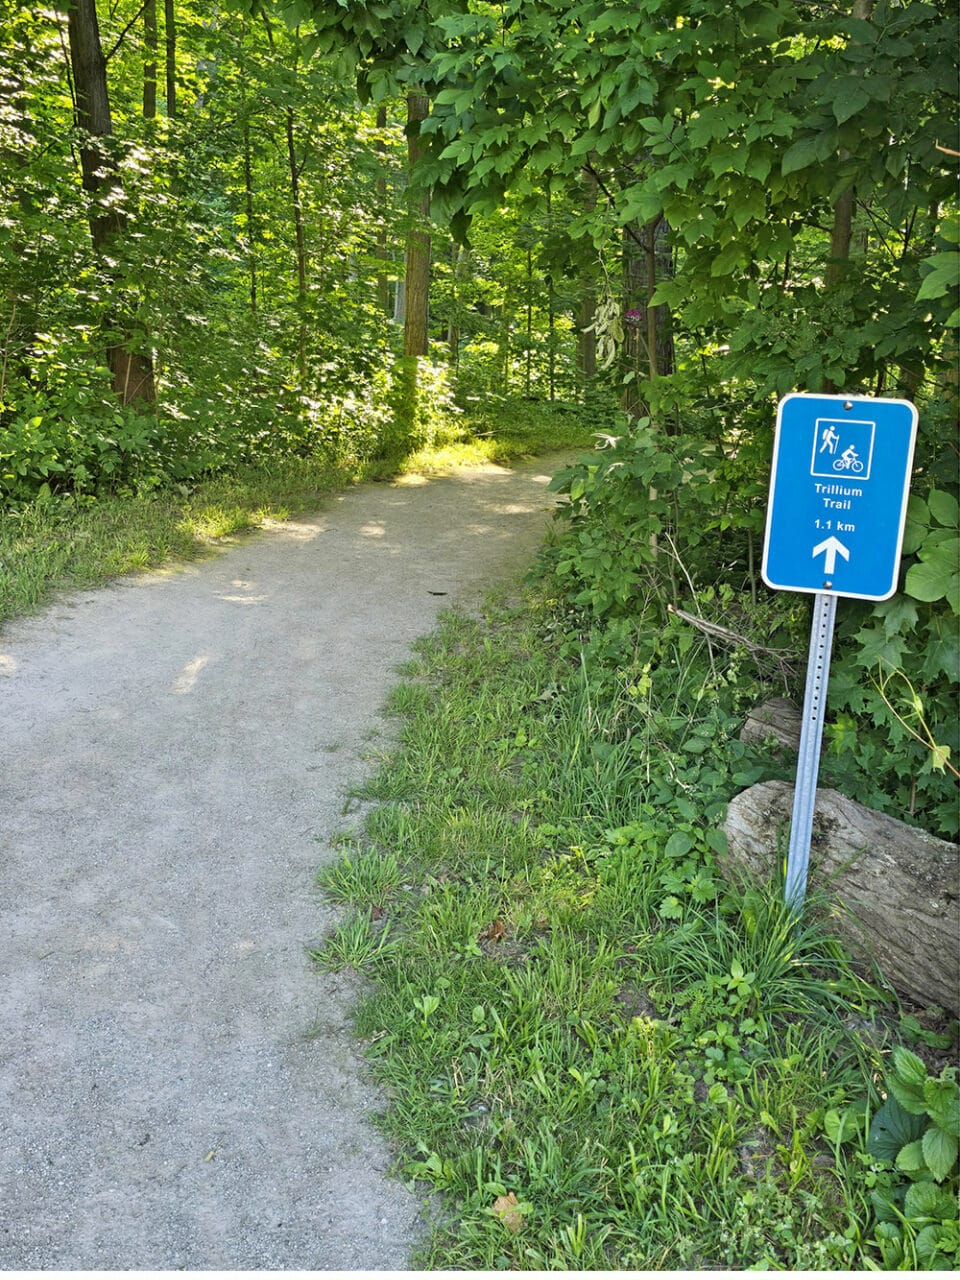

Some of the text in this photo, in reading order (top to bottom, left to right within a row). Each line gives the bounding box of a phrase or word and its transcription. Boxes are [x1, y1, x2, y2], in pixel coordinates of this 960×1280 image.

[814, 483, 863, 496] Trillium
[823, 497, 851, 509] Trail
[814, 519, 855, 531] 1.1 km
